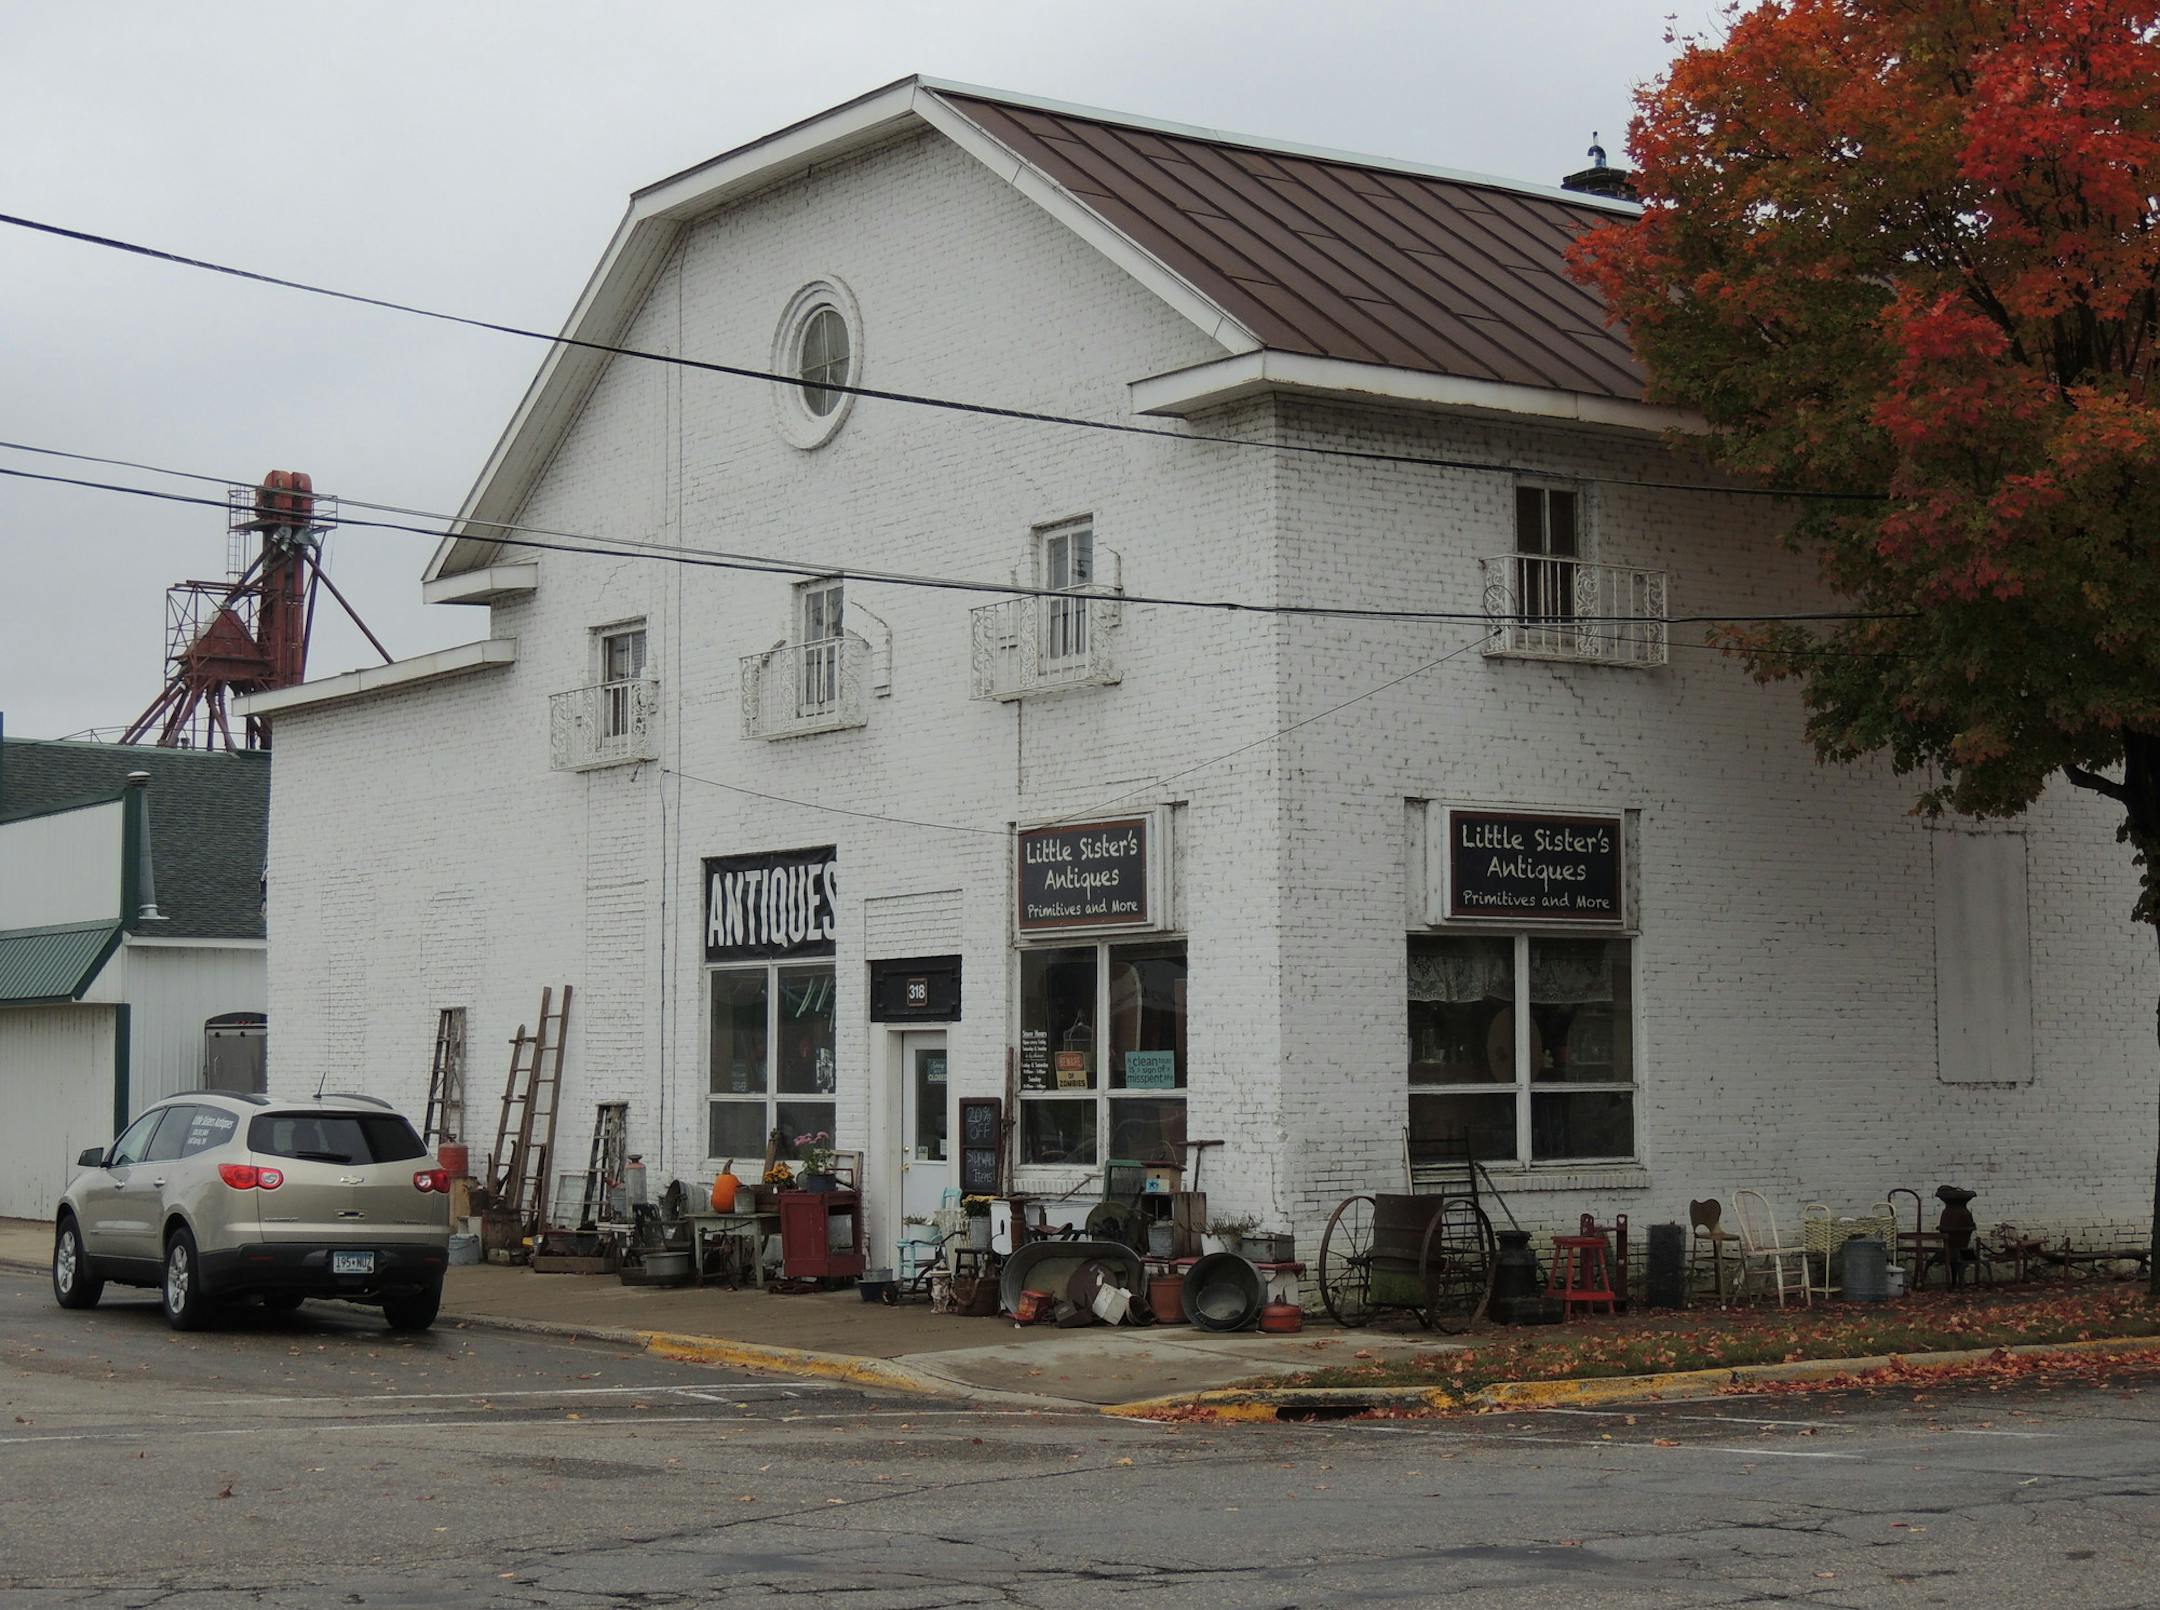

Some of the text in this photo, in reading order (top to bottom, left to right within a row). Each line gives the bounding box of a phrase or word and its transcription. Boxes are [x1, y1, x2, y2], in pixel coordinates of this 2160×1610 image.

[1026, 829, 1138, 864] Little Sister's
[1462, 824, 1610, 854] Little Sister's
[1044, 865, 1120, 900] Antiques
[1487, 854, 1587, 892] Antiques
[707, 860, 837, 948] ANTIQUES
[1027, 898, 1138, 919] Primitives and More
[1462, 889, 1610, 910] Primitives and More
[908, 984, 926, 999] 318
[1132, 1056, 1158, 1067] clean
[1060, 1079, 1086, 1088] ZOMBIES
[1127, 1073, 1163, 1084] misspent
[966, 1106, 992, 1123] 20%
[969, 1122, 991, 1140] OFF
